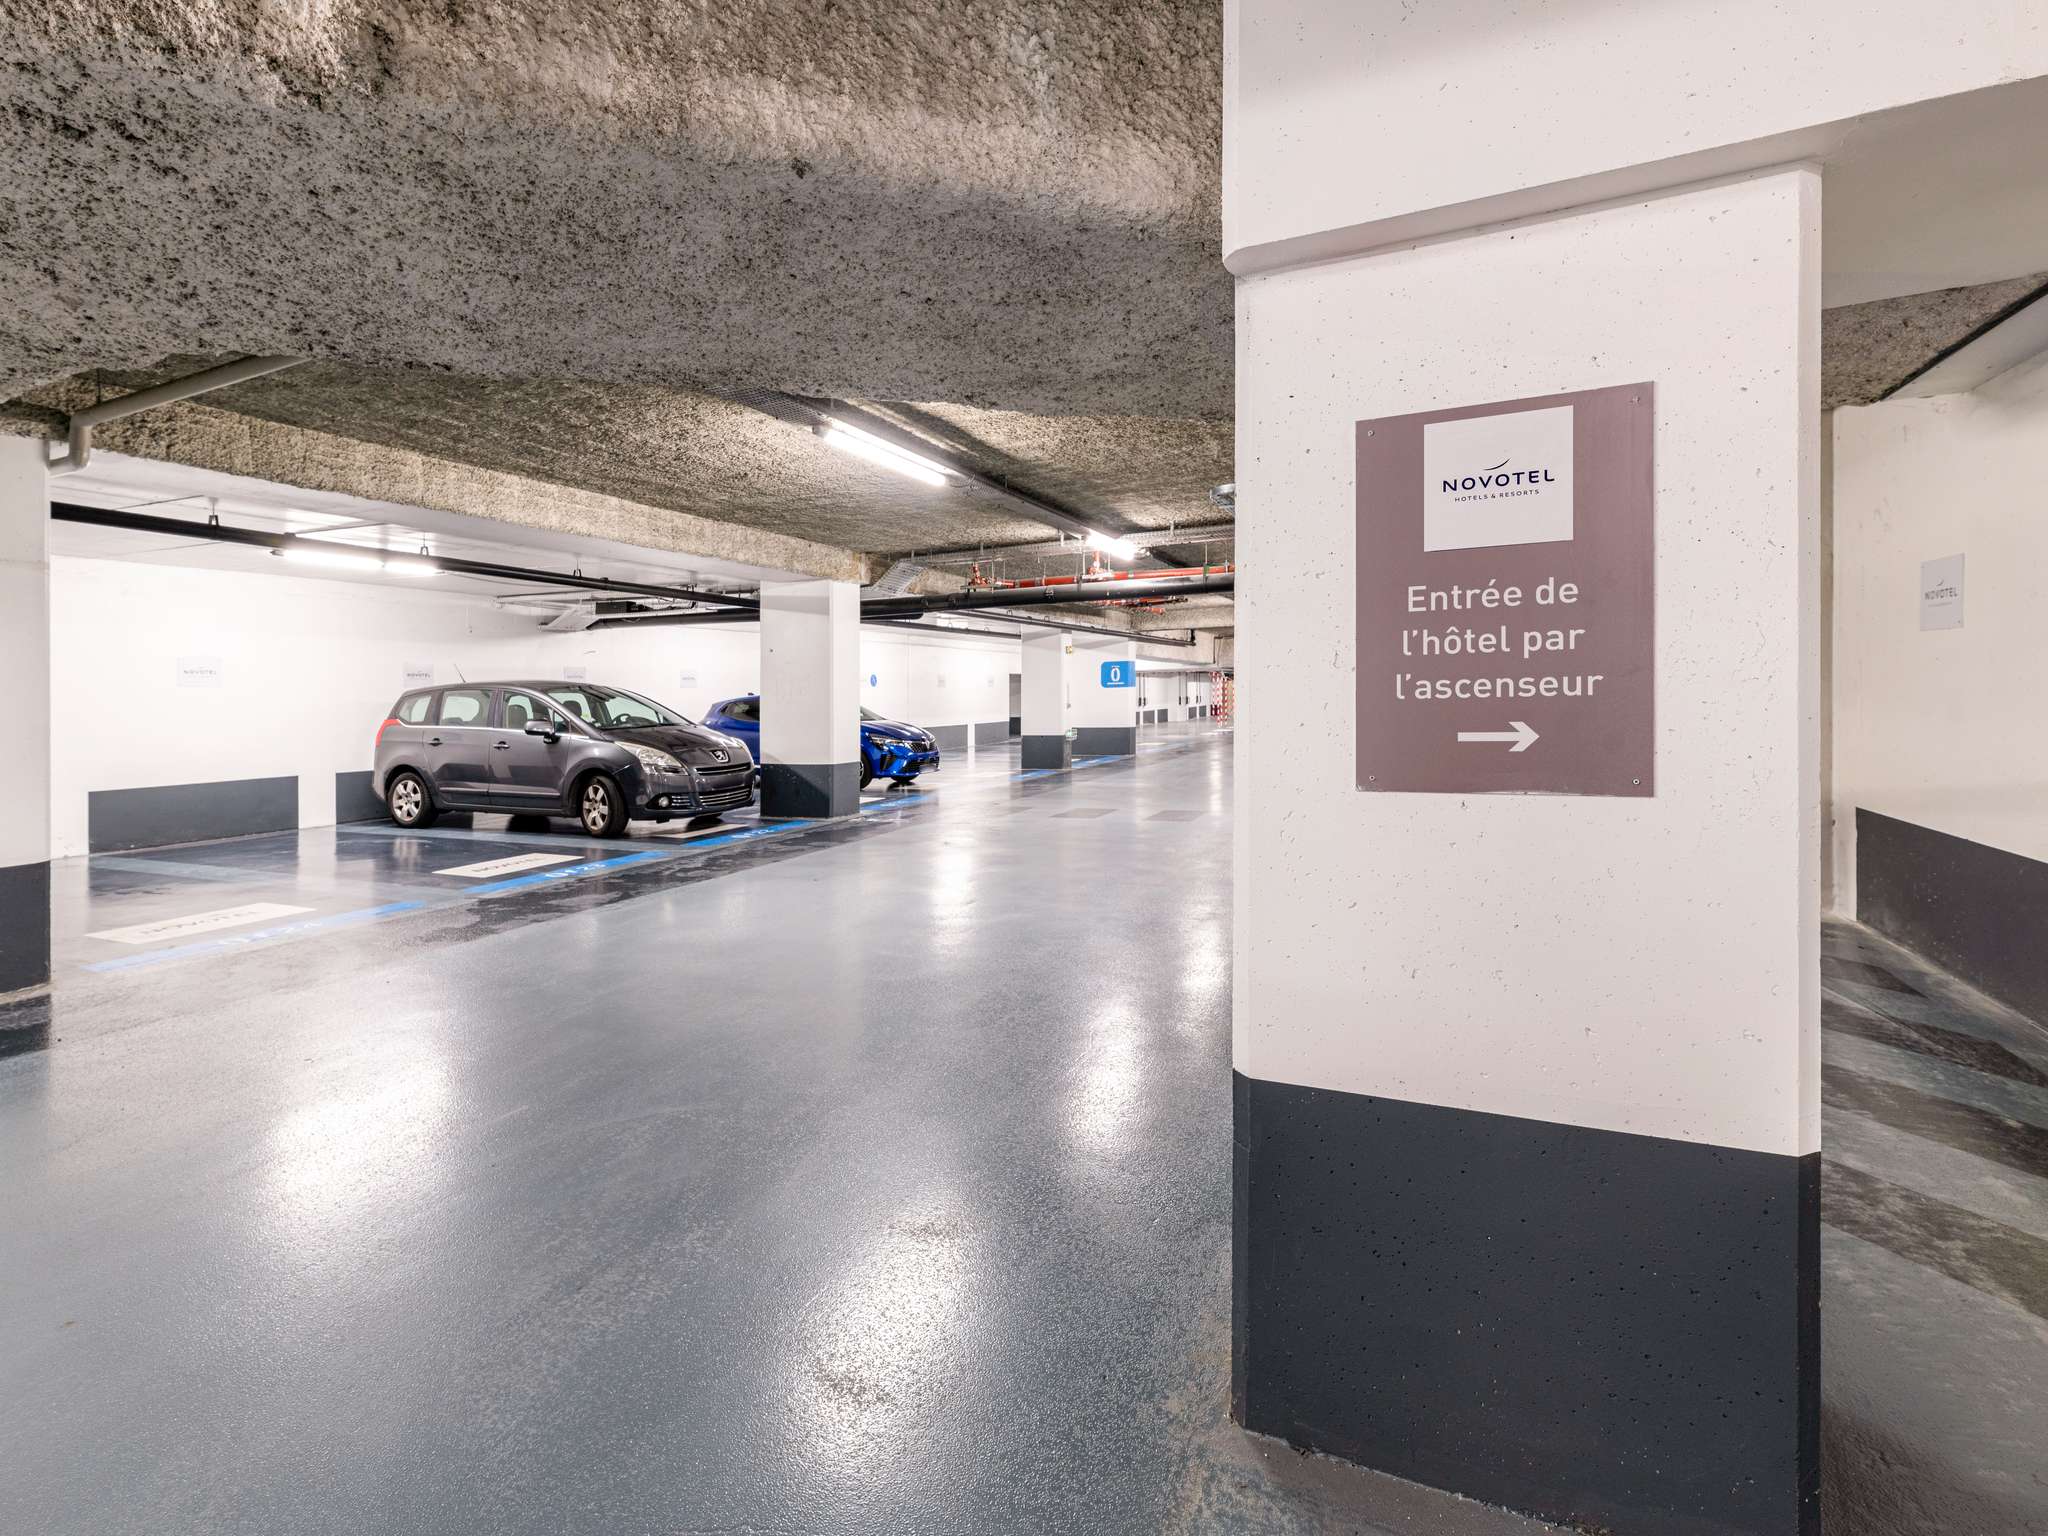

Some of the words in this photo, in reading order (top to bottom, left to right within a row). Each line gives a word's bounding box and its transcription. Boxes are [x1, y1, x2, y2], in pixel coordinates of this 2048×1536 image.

[1442, 469, 1556, 493] NOVOTEL
[1454, 494, 1489, 502] HOTELS
[1499, 488, 1540, 499] RESORTS
[1407, 578, 1523, 613] Entrée
[1535, 576, 1580, 606] de
[1402, 625, 1511, 657] l'hôtel
[1523, 628, 1587, 659] par
[1395, 673, 1605, 700] l'ascenseur
